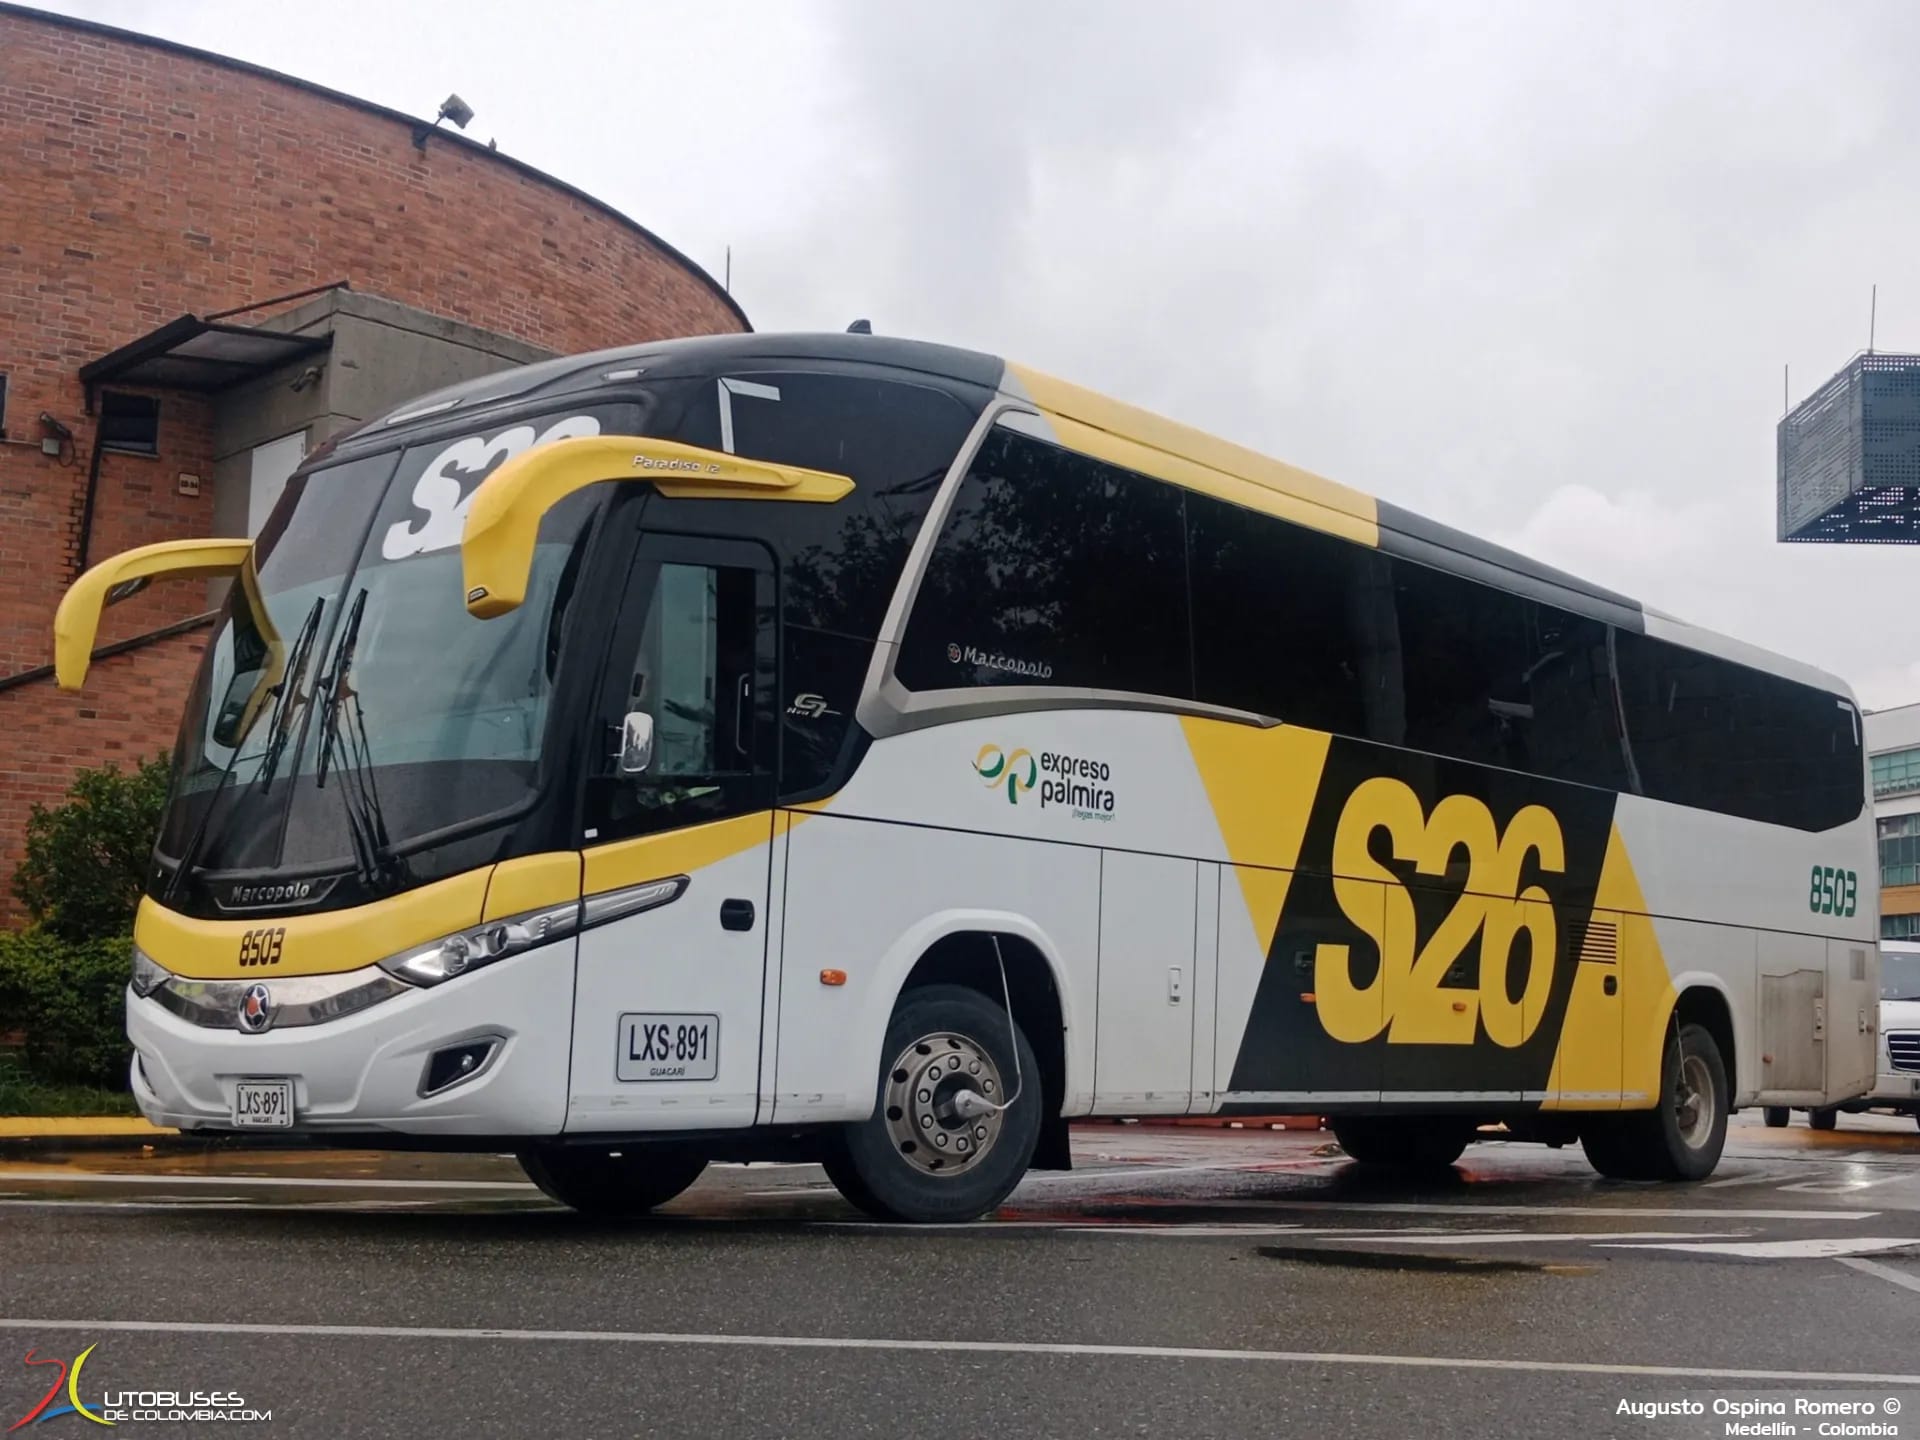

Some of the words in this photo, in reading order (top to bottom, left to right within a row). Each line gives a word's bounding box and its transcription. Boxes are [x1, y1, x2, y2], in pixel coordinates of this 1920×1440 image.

[632, 455, 700, 471] Paradiso
[704, 463, 720, 473] 12
[964, 645, 1052, 678] Marcopolo
[1041, 752, 1110, 781] expreso
[1041, 777, 1115, 811] palmira
[231, 882, 310, 903] Marcopolo
[1810, 865, 1857, 918] 8503
[1314, 776, 1566, 1048] S26
[239, 927, 286, 967] 8503
